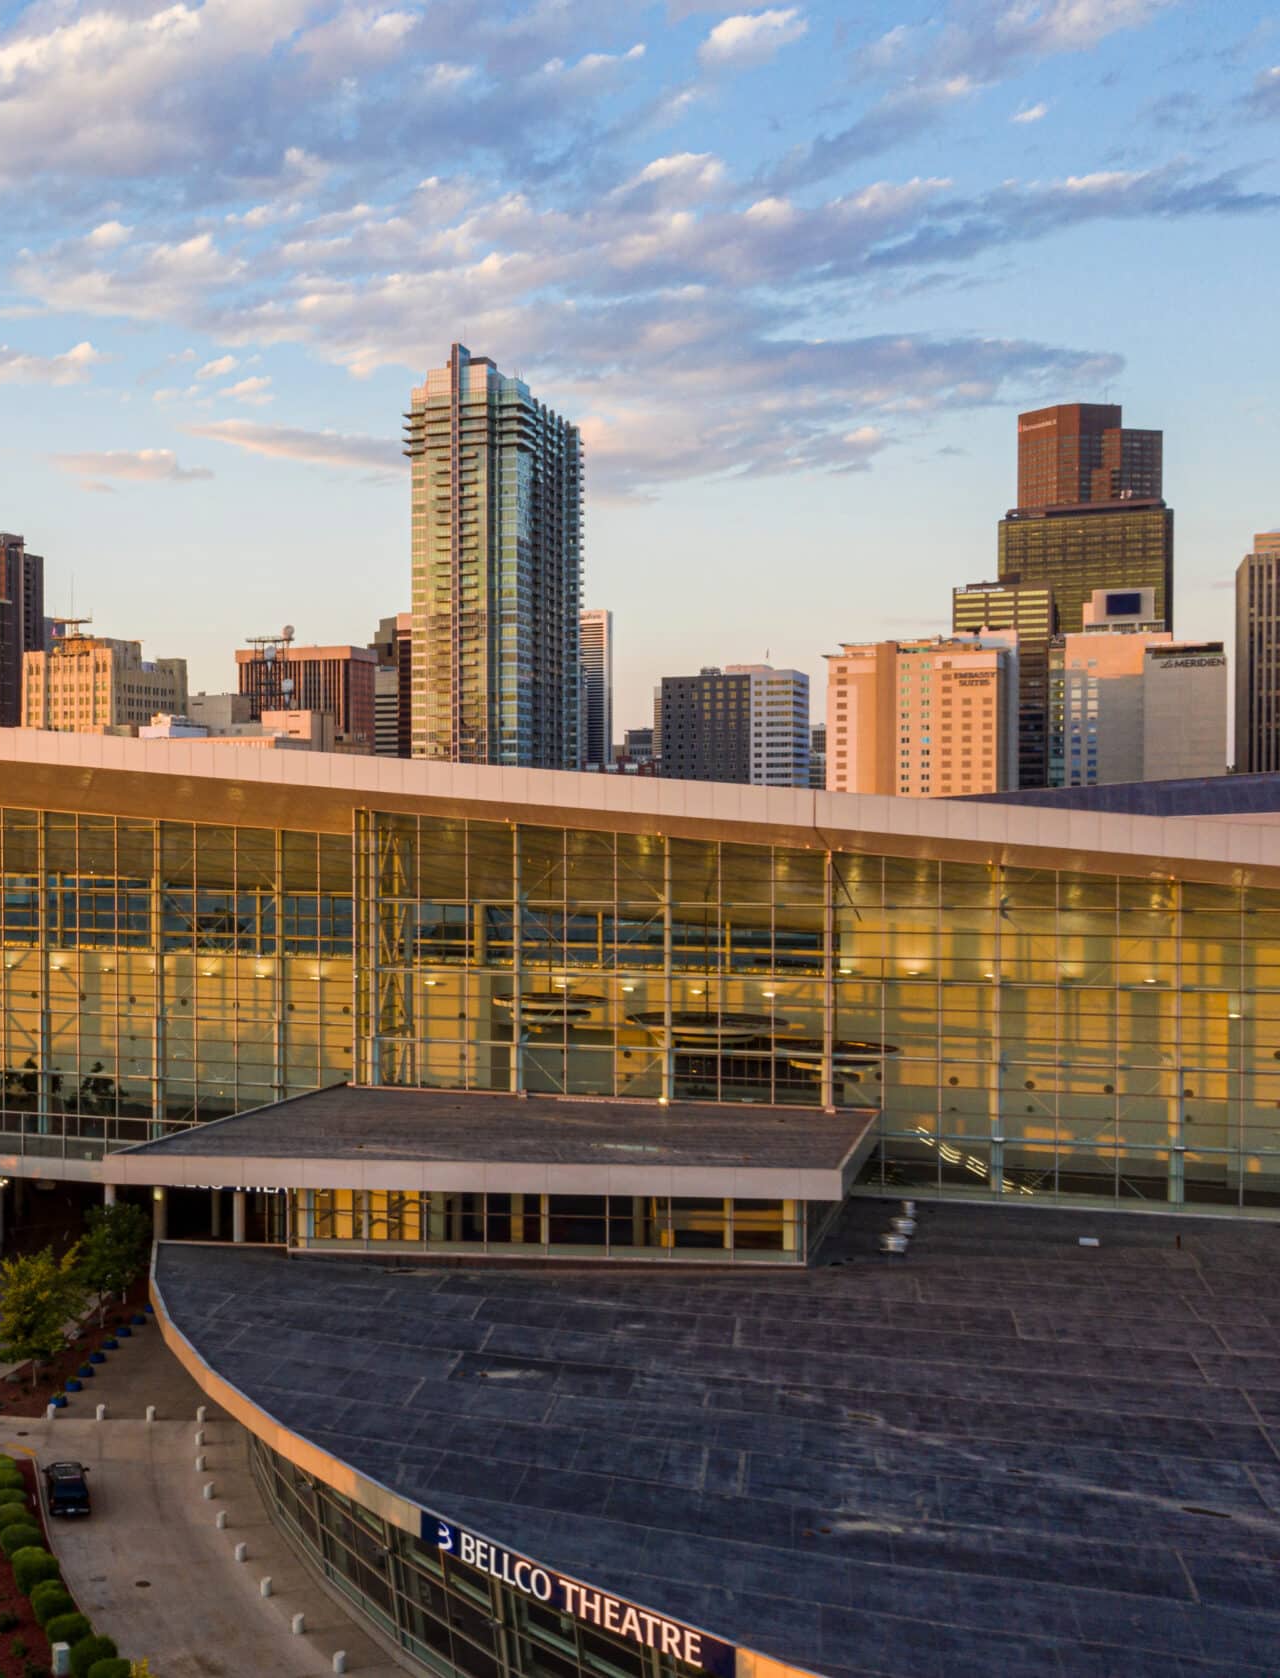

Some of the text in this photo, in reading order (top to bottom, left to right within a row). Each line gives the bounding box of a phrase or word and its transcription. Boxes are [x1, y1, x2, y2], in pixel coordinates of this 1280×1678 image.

[1174, 657, 1227, 668] MERIDIEN
[959, 679, 991, 687] SUITES
[460, 1531, 704, 1668] BELLCO THEATRE
